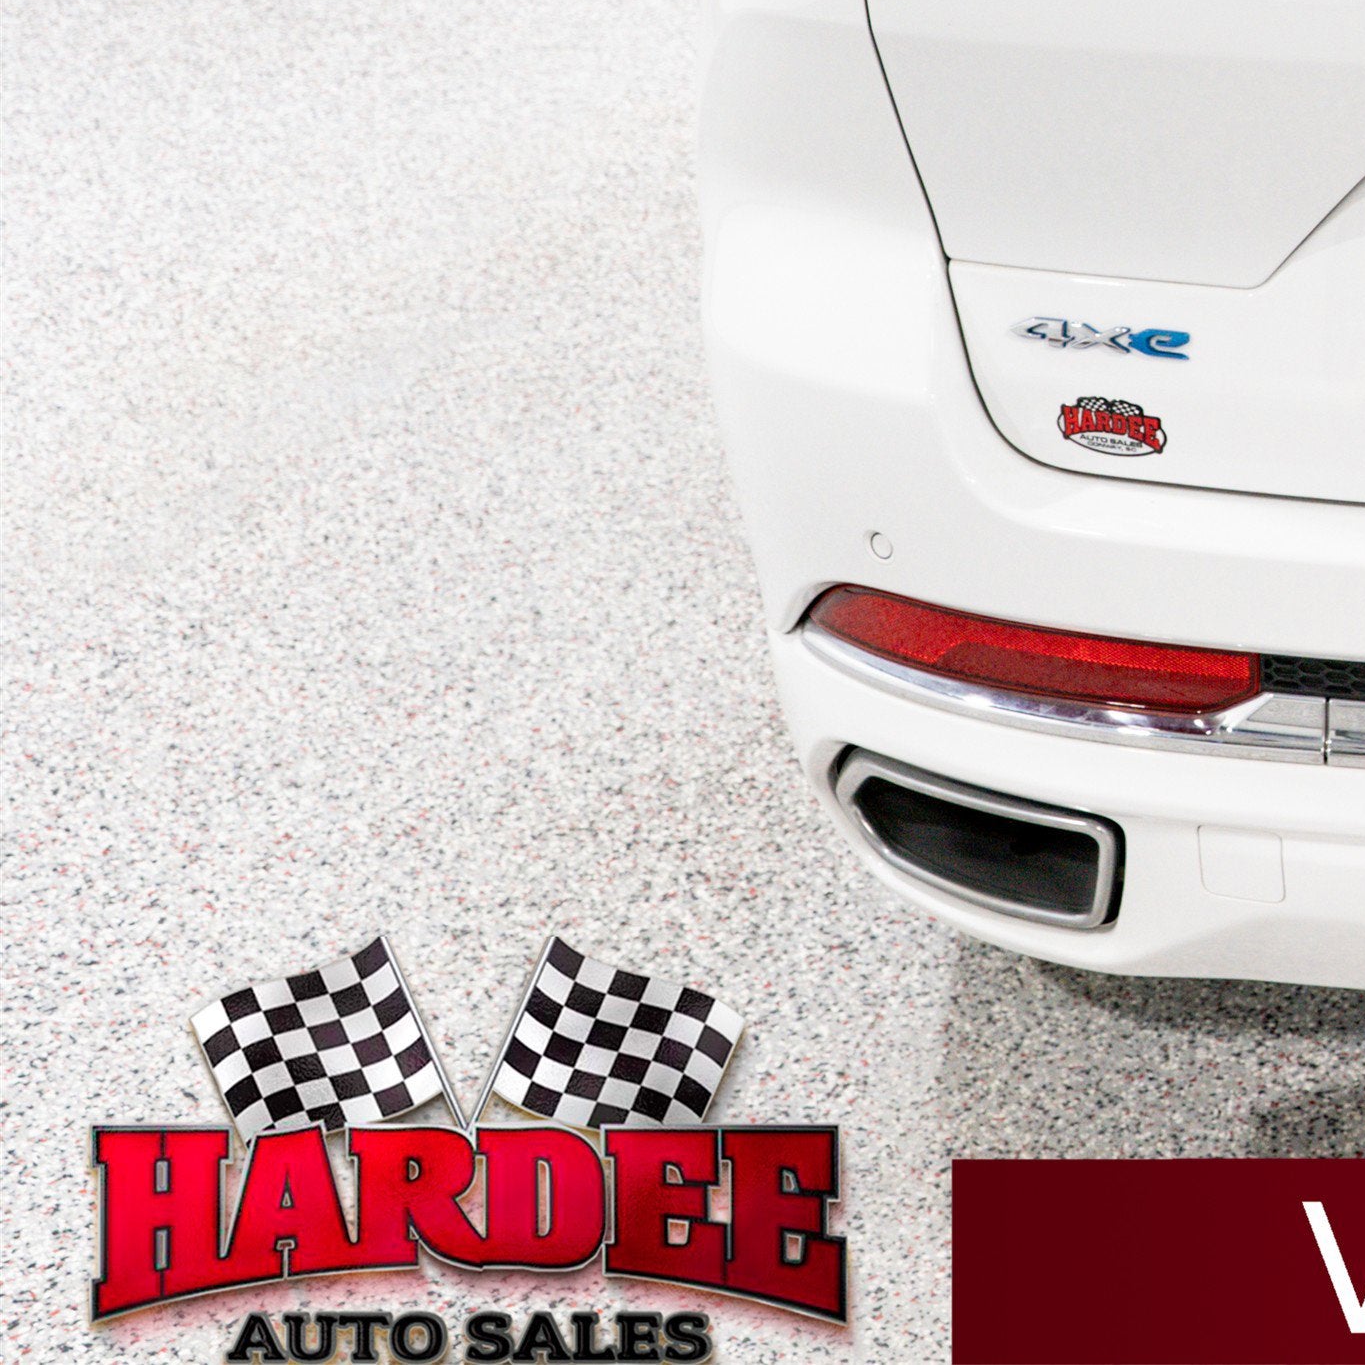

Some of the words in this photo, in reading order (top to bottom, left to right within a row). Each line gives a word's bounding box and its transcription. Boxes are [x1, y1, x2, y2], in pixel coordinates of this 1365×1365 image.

[1061, 404, 1163, 454] HARDEE
[1080, 434, 1108, 444] AUTO
[1110, 438, 1143, 448] SALES
